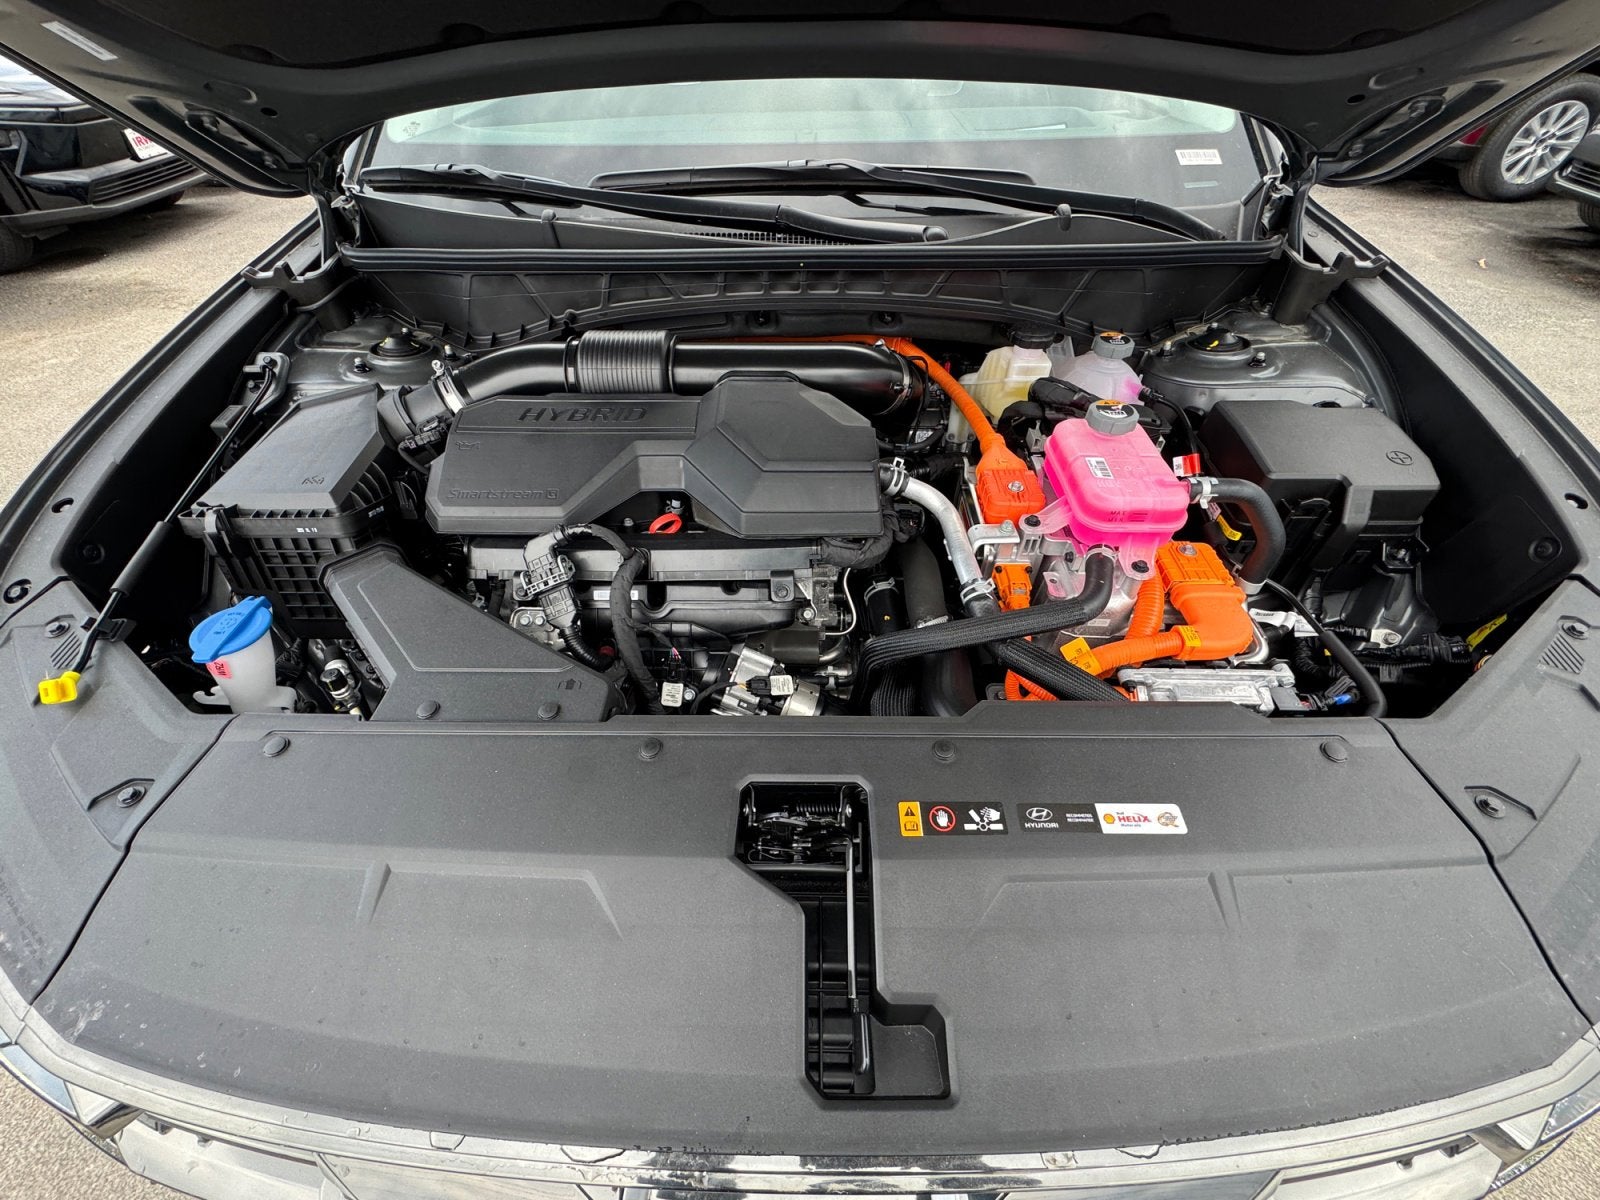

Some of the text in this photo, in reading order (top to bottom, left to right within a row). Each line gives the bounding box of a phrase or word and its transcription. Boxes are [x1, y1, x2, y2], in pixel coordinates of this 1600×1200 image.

[516, 407, 647, 423] HYBRID
[448, 488, 544, 500] Smartstream
[1117, 815, 1152, 823] HELIX
